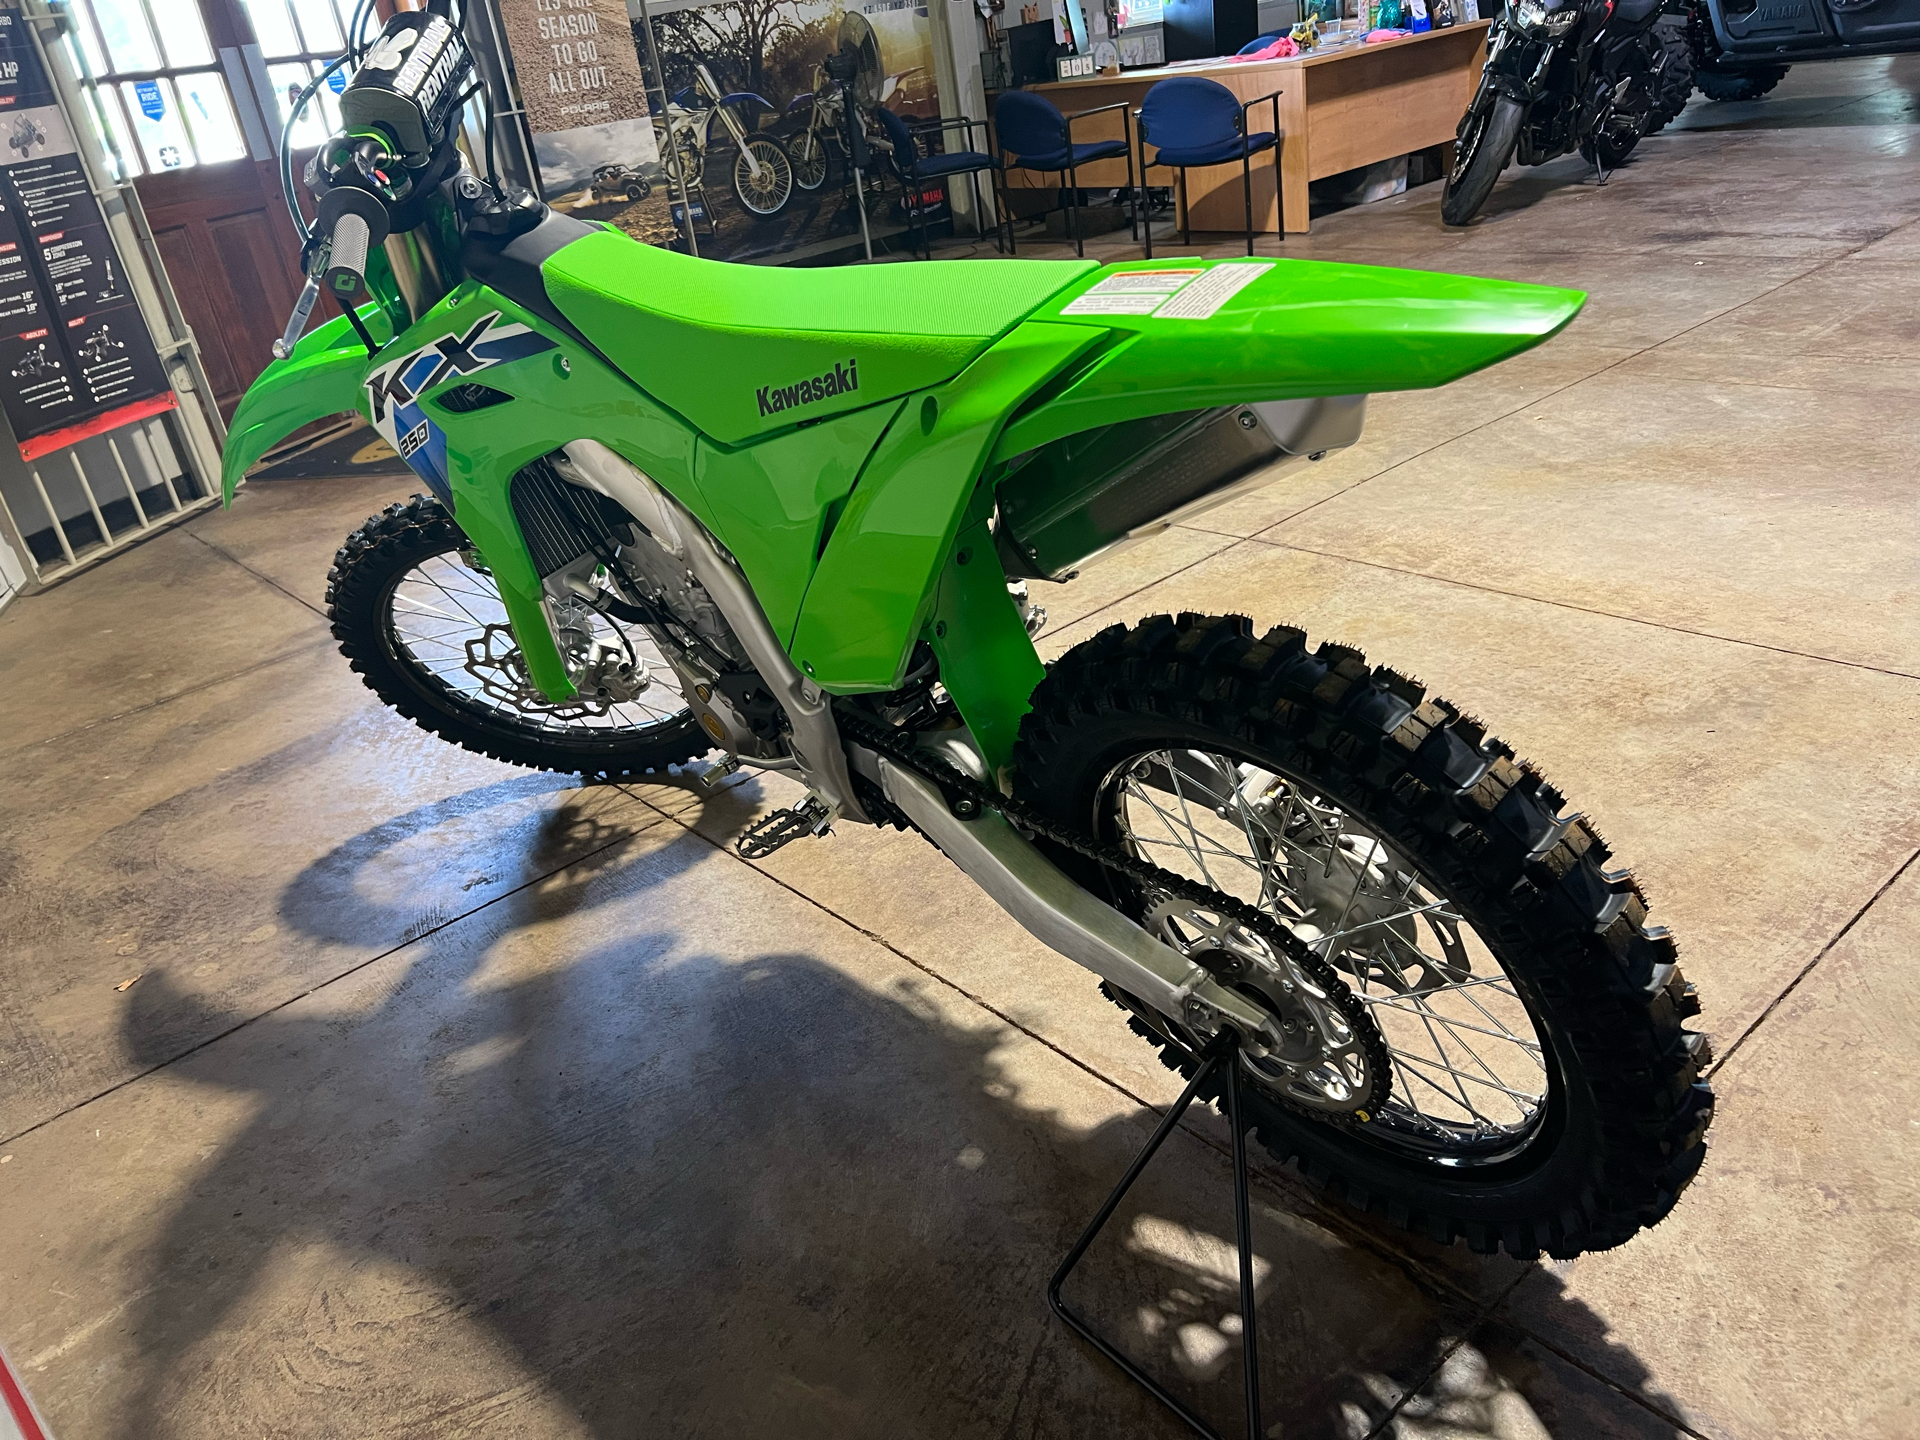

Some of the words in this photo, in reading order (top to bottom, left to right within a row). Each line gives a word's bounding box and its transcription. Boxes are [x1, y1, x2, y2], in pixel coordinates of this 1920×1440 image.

[538, 12, 599, 39] SEASON
[1759, 5, 1802, 21] YAMAHA
[392, 15, 452, 97] RENTHAL
[551, 43, 573, 66] TO
[577, 40, 598, 63] GO
[2, 62, 19, 78] HP
[417, 34, 465, 117] RENTHAL
[549, 71, 577, 94] ALL
[580, 66, 612, 90] OUT.
[141, 92, 159, 102] RIDE
[560, 101, 610, 116] POLARIS
[911, 189, 944, 207] YMAHA
[43, 248, 52, 261] 5
[26, 329, 47, 340] AGILITY
[365, 311, 500, 424] KX
[756, 358, 858, 417] Kawasaki
[400, 420, 429, 458] 250
